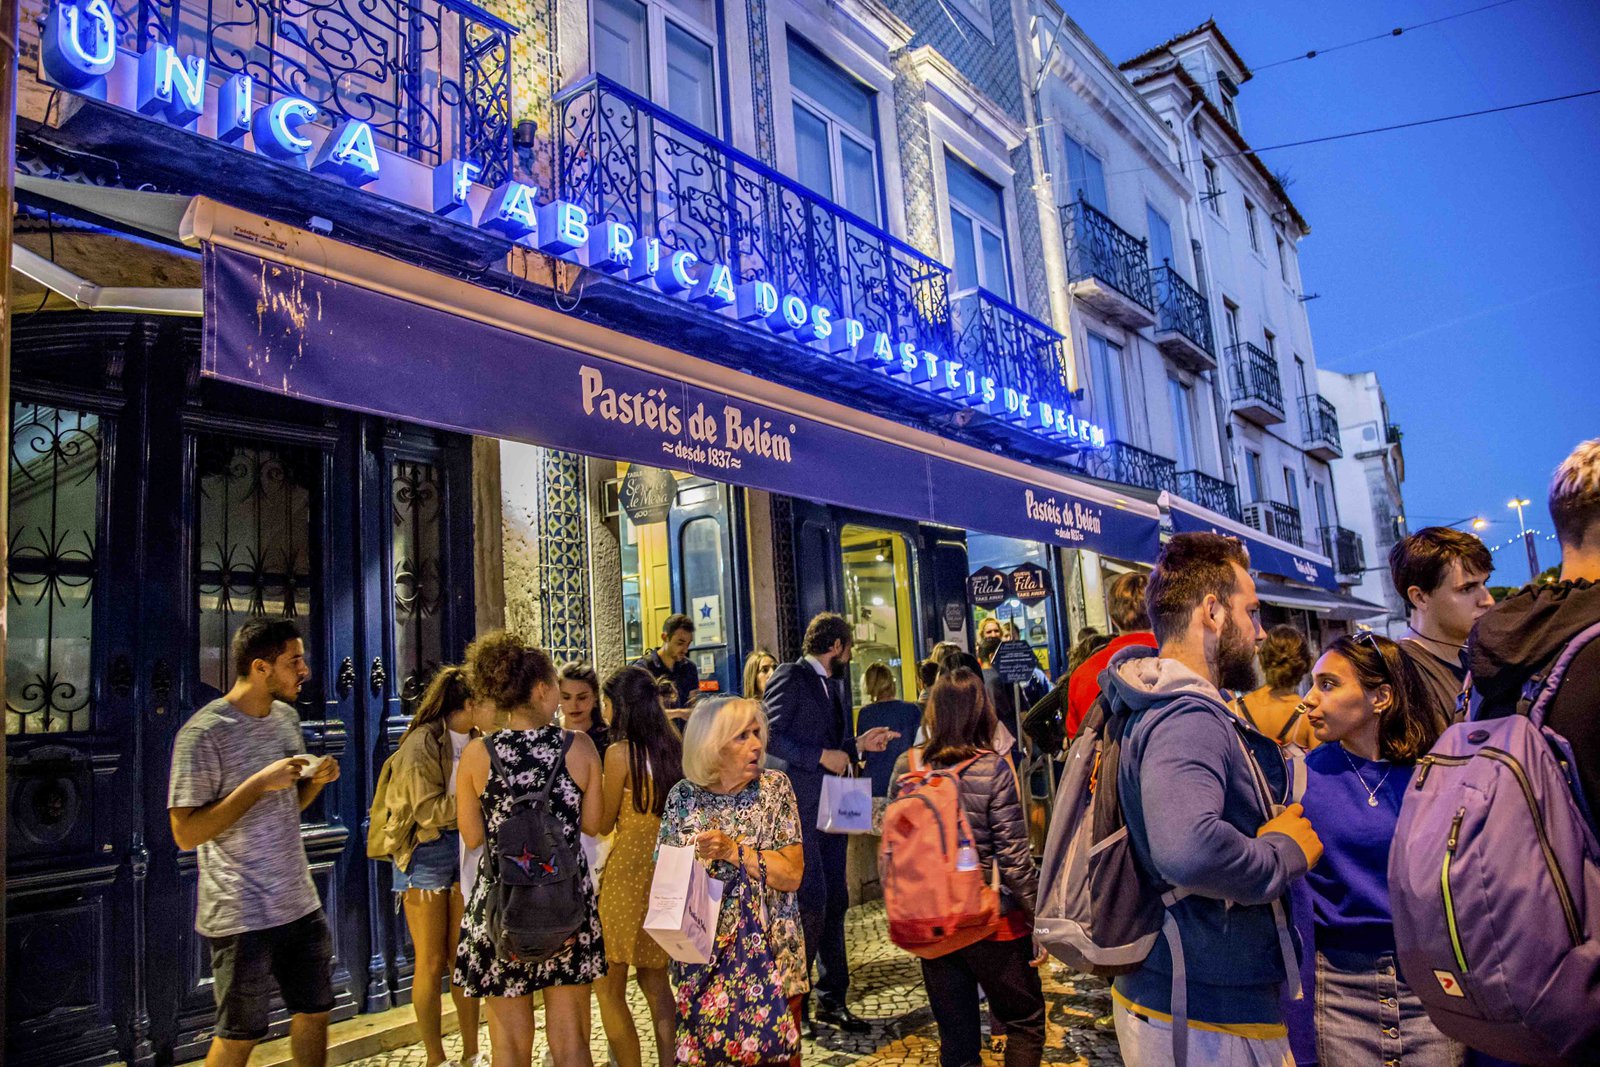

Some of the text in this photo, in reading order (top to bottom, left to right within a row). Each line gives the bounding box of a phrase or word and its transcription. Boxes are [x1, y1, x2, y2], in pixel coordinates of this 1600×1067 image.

[756, 280, 832, 339] DOS
[846, 317, 996, 403] PASTEIS
[1004, 387, 1032, 416] DE
[579, 364, 682, 435] Pastéis
[688, 402, 717, 444] de
[675, 441, 732, 469] desde 1837
[1062, 502, 1074, 527] de
[972, 574, 1004, 595] Fila 2
[1014, 569, 1044, 592] Fila 1
